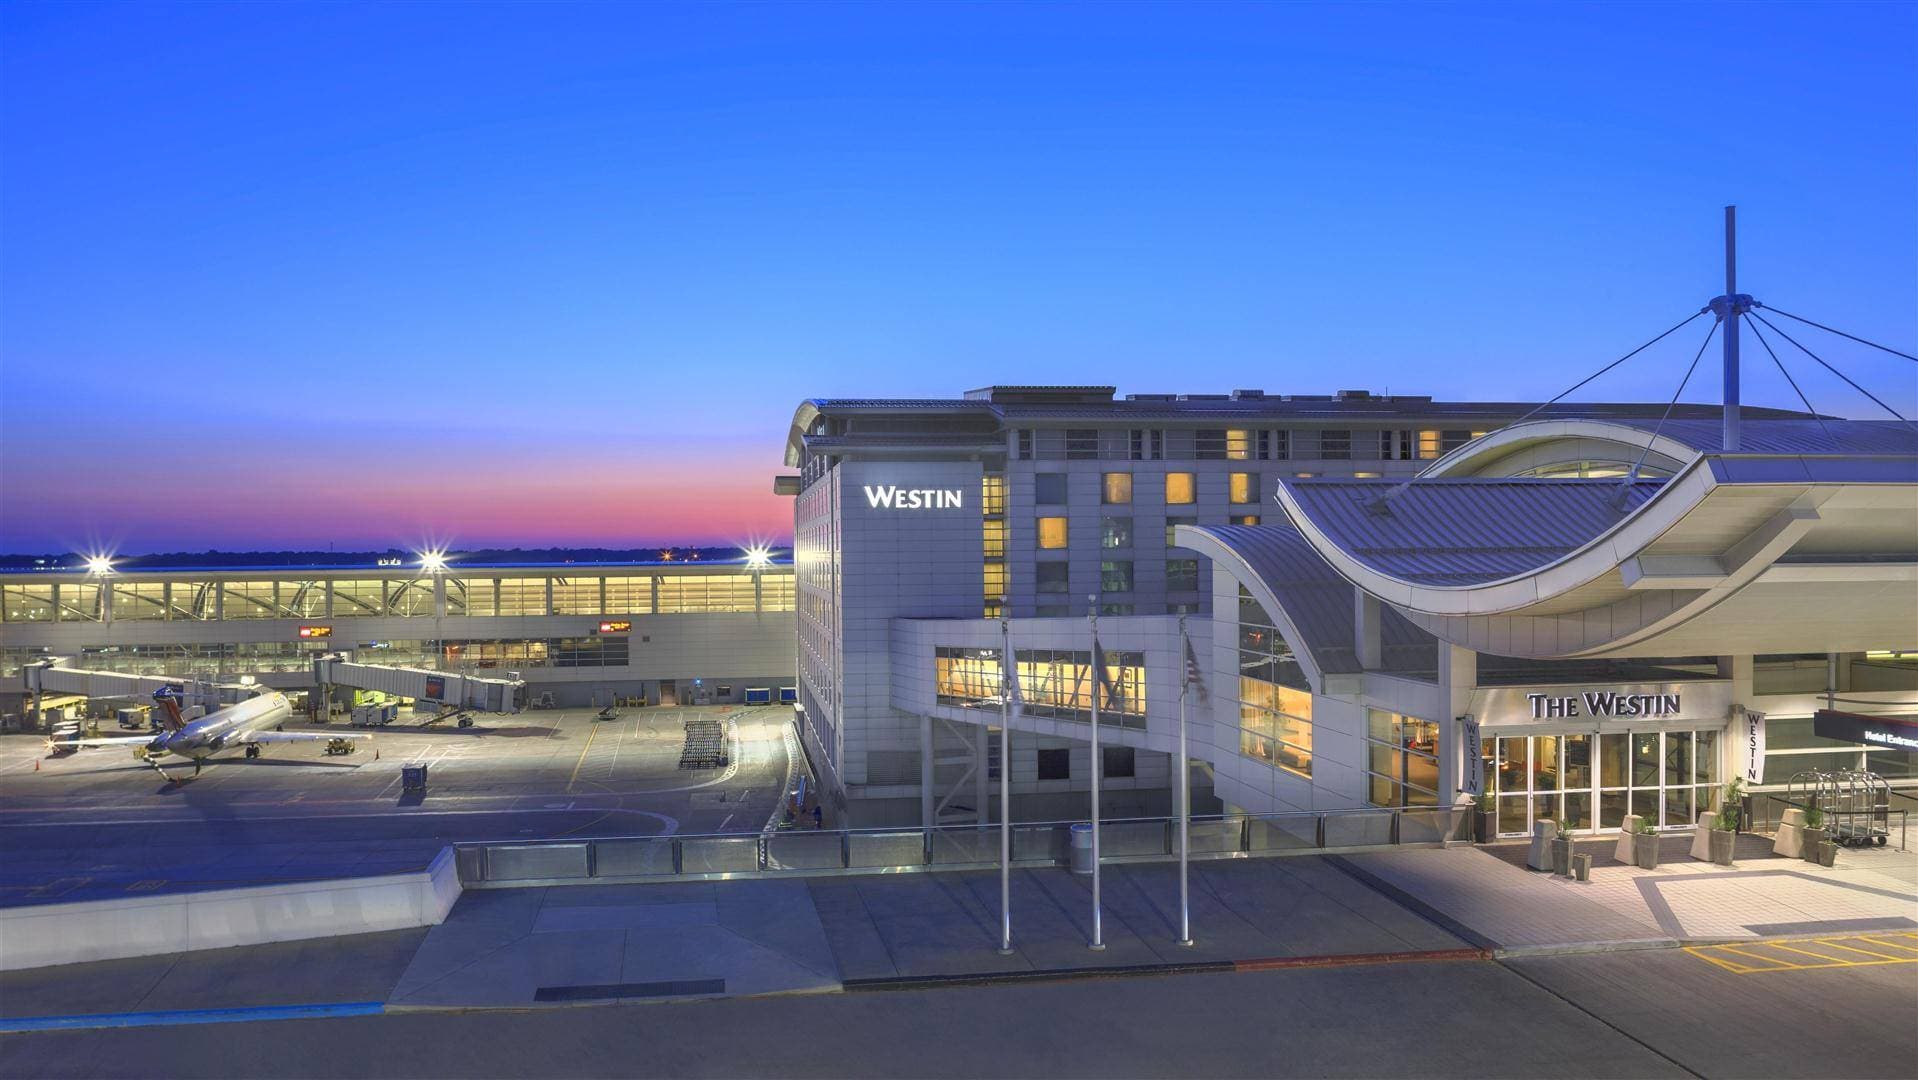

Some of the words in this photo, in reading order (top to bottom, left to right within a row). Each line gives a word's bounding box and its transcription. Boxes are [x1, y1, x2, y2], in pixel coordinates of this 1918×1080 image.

[1466, 723, 1478, 792] WESTIN
[1747, 713, 1760, 780] WESTIN
[1864, 730, 1887, 743] Hotel
